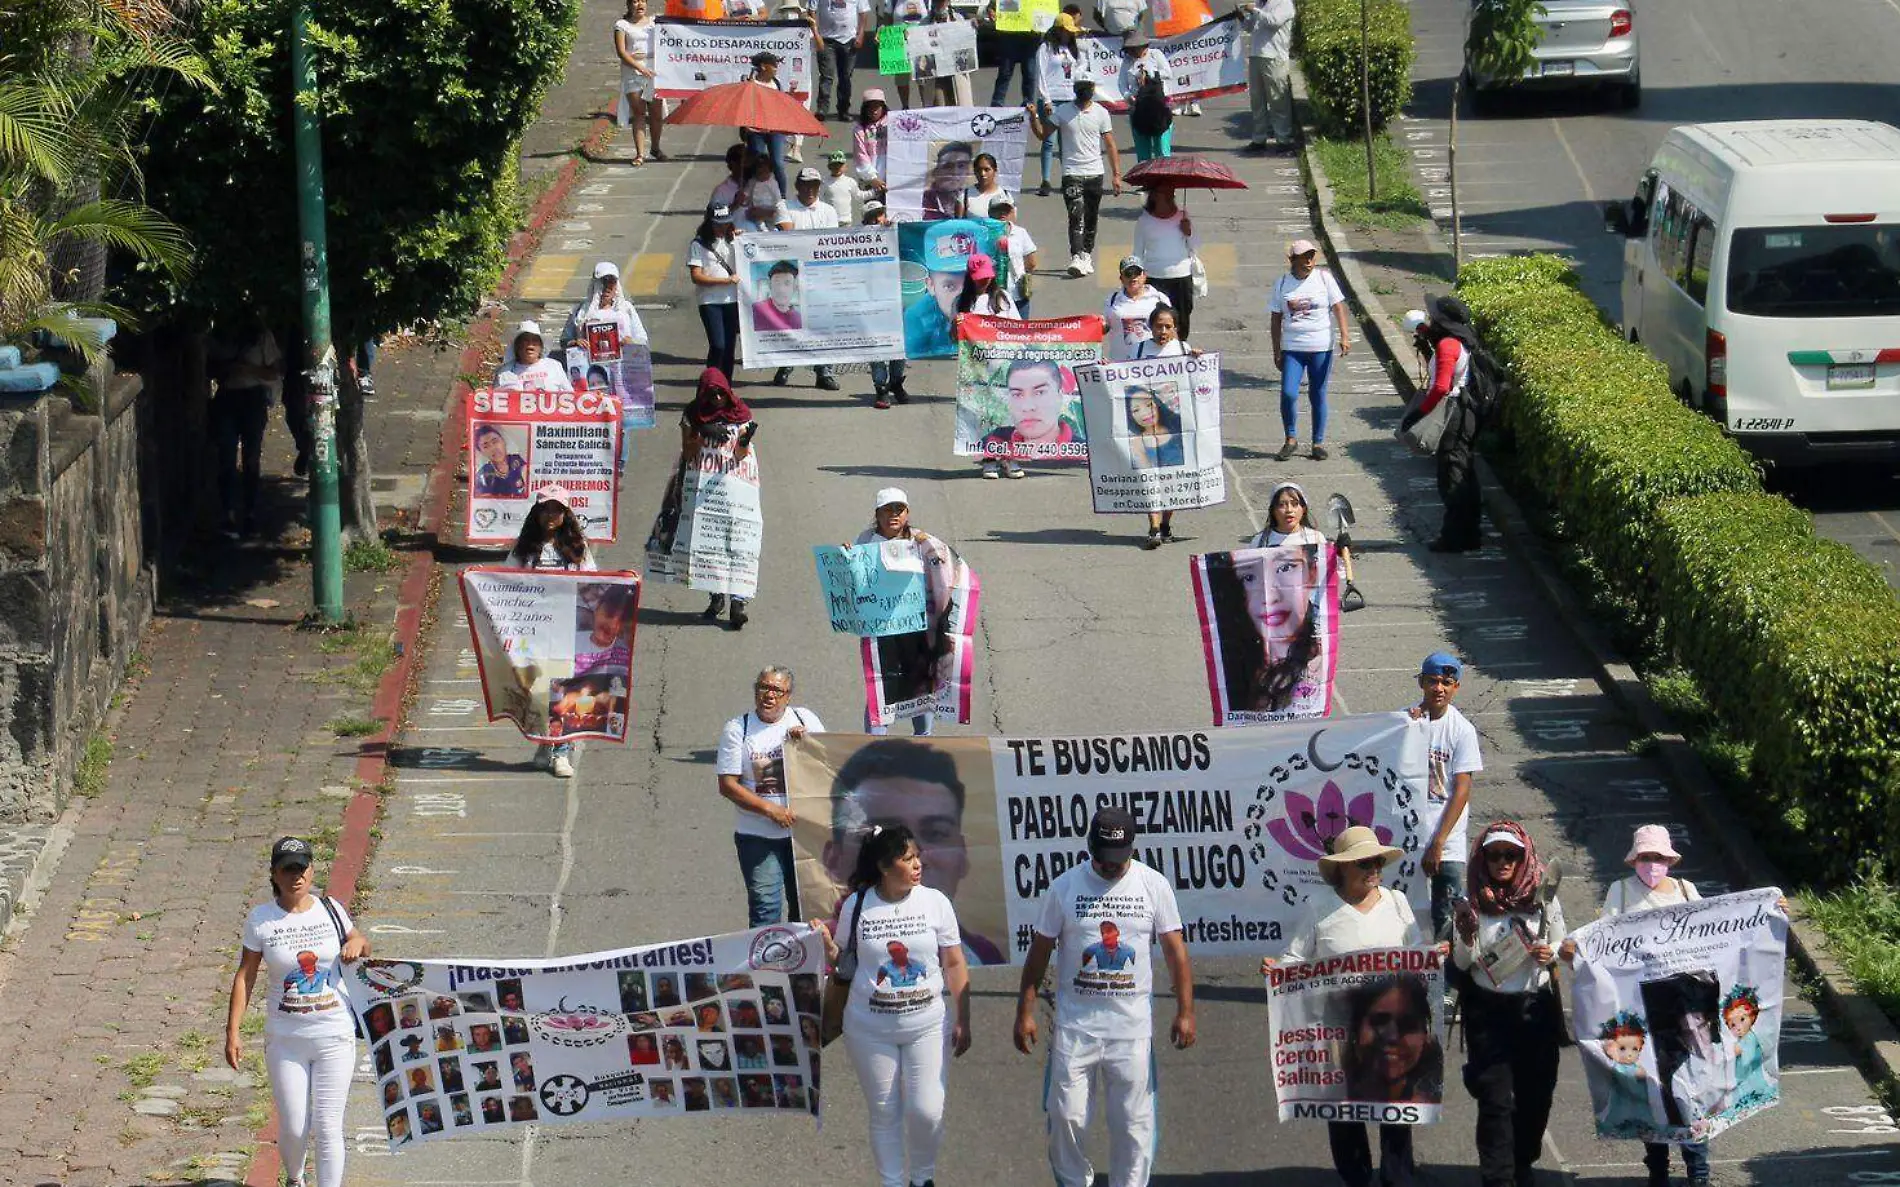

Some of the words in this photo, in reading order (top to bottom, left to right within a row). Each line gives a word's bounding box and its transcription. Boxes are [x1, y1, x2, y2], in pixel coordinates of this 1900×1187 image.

[660, 39, 683, 48] POR
[686, 39, 706, 48] LOS
[710, 38, 804, 50] DESAPARECIDOS:
[668, 52, 683, 62] SU
[685, 53, 732, 64] FAMILIA
[1093, 50, 1117, 60] POR
[1168, 56, 1188, 68] LOS
[1191, 51, 1228, 65] BUSCA
[1102, 65, 1117, 76] SU
[875, 234, 882, 243] A
[813, 247, 889, 260] ENCONTRARLO
[592, 325, 613, 334] STOP
[978, 319, 1025, 329] Jonathan
[1033, 332, 1063, 342] Rojas
[1074, 349, 1095, 360] casa
[1079, 370, 1100, 383] TE
[1106, 358, 1217, 382] BUSCAMOS!!
[473, 391, 510, 414] SE
[520, 392, 617, 416] BUSCA
[536, 425, 610, 439] Maximiliano
[965, 441, 984, 454] Inf.
[987, 442, 1010, 454] Cel.
[1014, 442, 1034, 455] 777
[1038, 442, 1058, 455] 440
[1060, 442, 1088, 456] 9596
[1169, 495, 1209, 506] Morelos
[1007, 739, 1046, 776] TE
[1052, 732, 1211, 776] BUSCAMOS
[1008, 793, 1089, 840] PABLO
[1172, 844, 1246, 891] LUGO
[1088, 902, 1100, 910] de
[1102, 902, 1131, 910] Marzo
[1586, 931, 1645, 967] Diego
[1653, 904, 1770, 945] Armando
[1270, 950, 1440, 988] DESAPARECIDA
[1323, 978, 1337, 986] DE
[1274, 1023, 1345, 1048] Jessica
[1276, 1046, 1331, 1067] Cerón
[1277, 1068, 1344, 1088] Salinas
[1294, 1103, 1420, 1122] MORELOS
